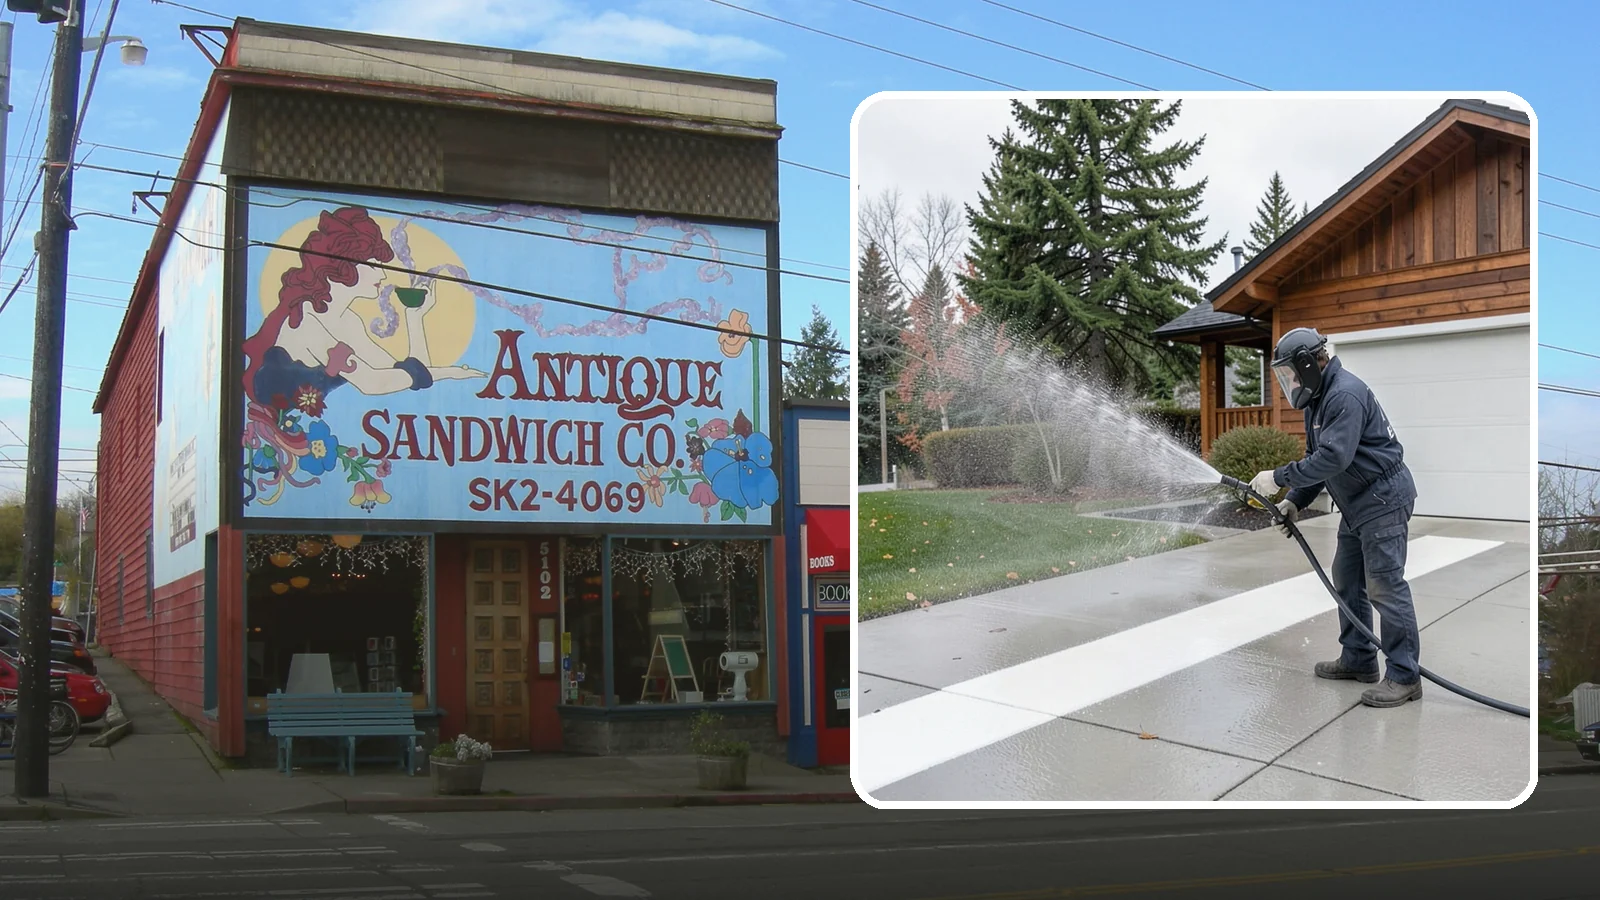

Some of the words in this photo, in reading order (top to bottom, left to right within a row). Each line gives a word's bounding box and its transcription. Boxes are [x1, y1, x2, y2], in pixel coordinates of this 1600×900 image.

[476, 329, 723, 421] ANTIQUE
[361, 409, 604, 467] SANDWICH
[617, 422, 685, 469] CO.
[468, 477, 645, 513] SK2-4069
[540, 542, 551, 600] 5102
[809, 555, 835, 568] BOOKS
